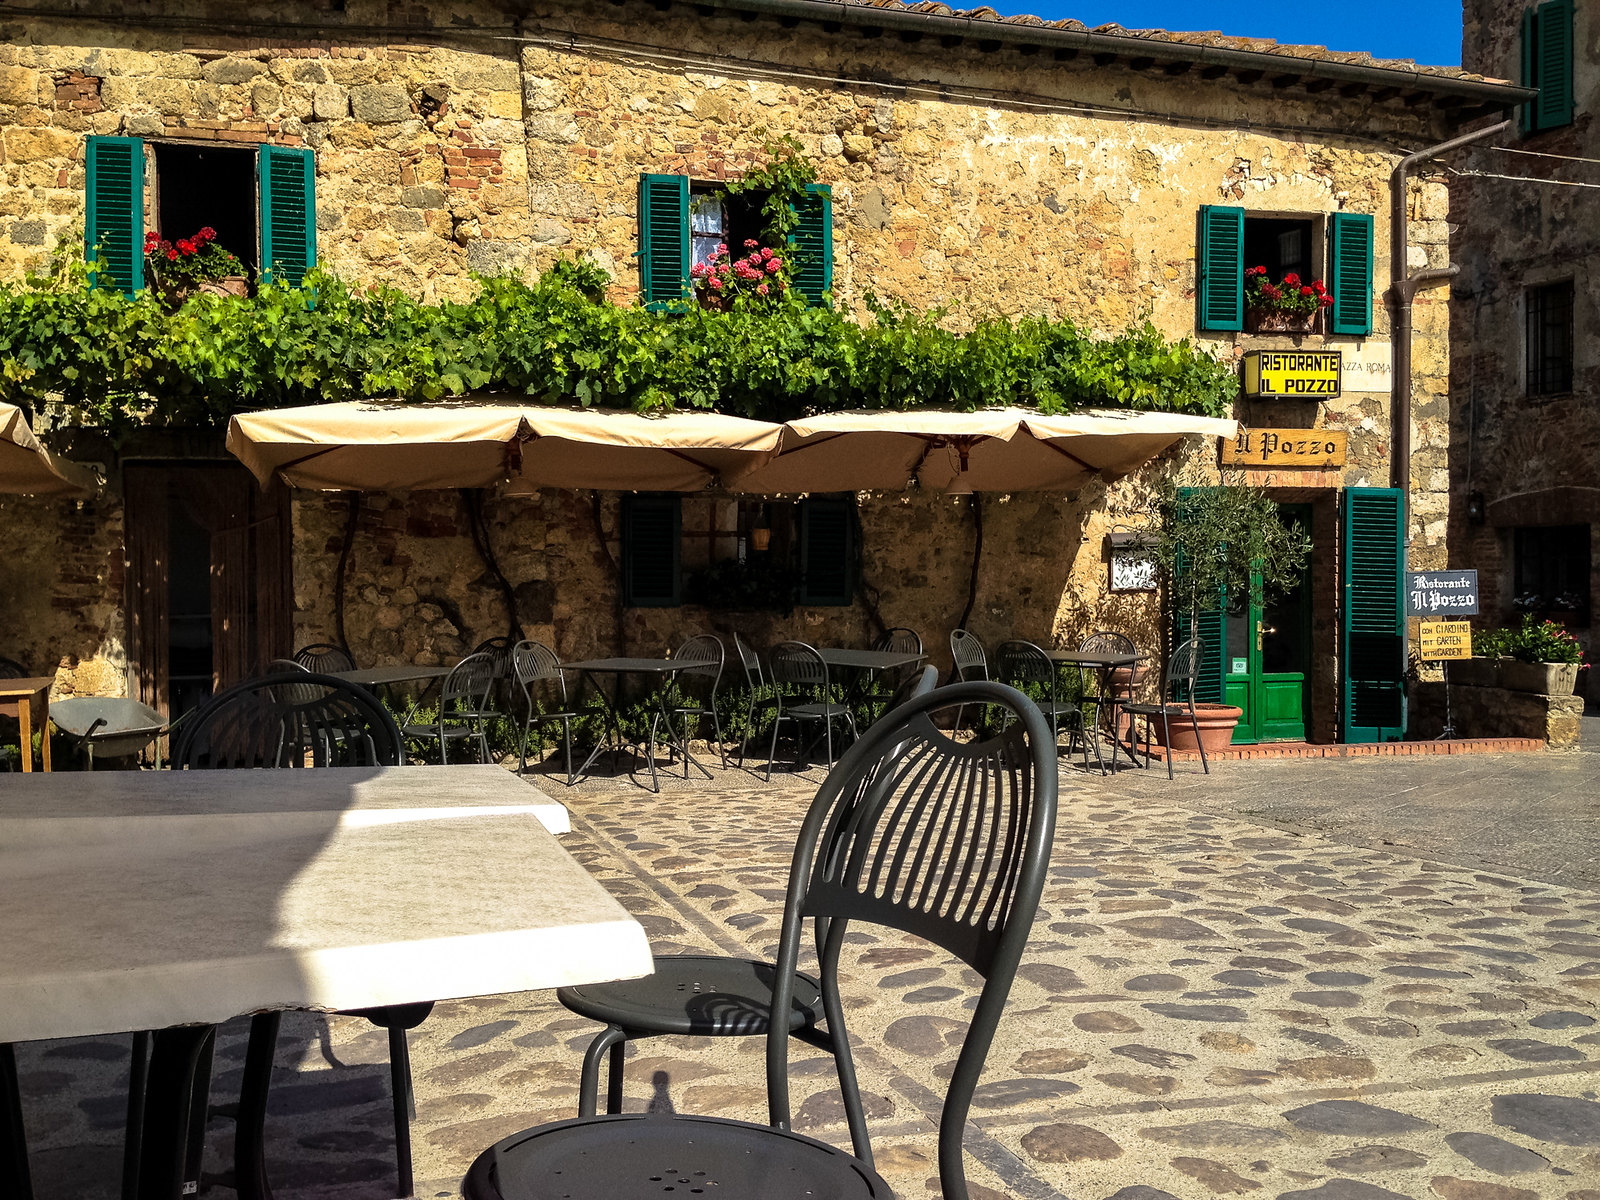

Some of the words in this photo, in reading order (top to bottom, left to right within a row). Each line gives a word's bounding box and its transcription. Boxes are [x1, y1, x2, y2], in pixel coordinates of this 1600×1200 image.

[1262, 355, 1338, 371] RISTORANTE
[1340, 361, 1363, 371] AZZA
[1366, 362, 1391, 373] ROMA
[1262, 379, 1276, 394] IL
[1285, 379, 1338, 394] POZZO
[1235, 432, 1251, 454] Il
[1260, 432, 1336, 460] Pozzo
[1413, 574, 1471, 589] Ristorante
[1410, 590, 1428, 610] Il
[1429, 589, 1475, 611] Pozzo
[1437, 636, 1462, 645] GARTEN
[1437, 647, 1463, 656] GARDEN
